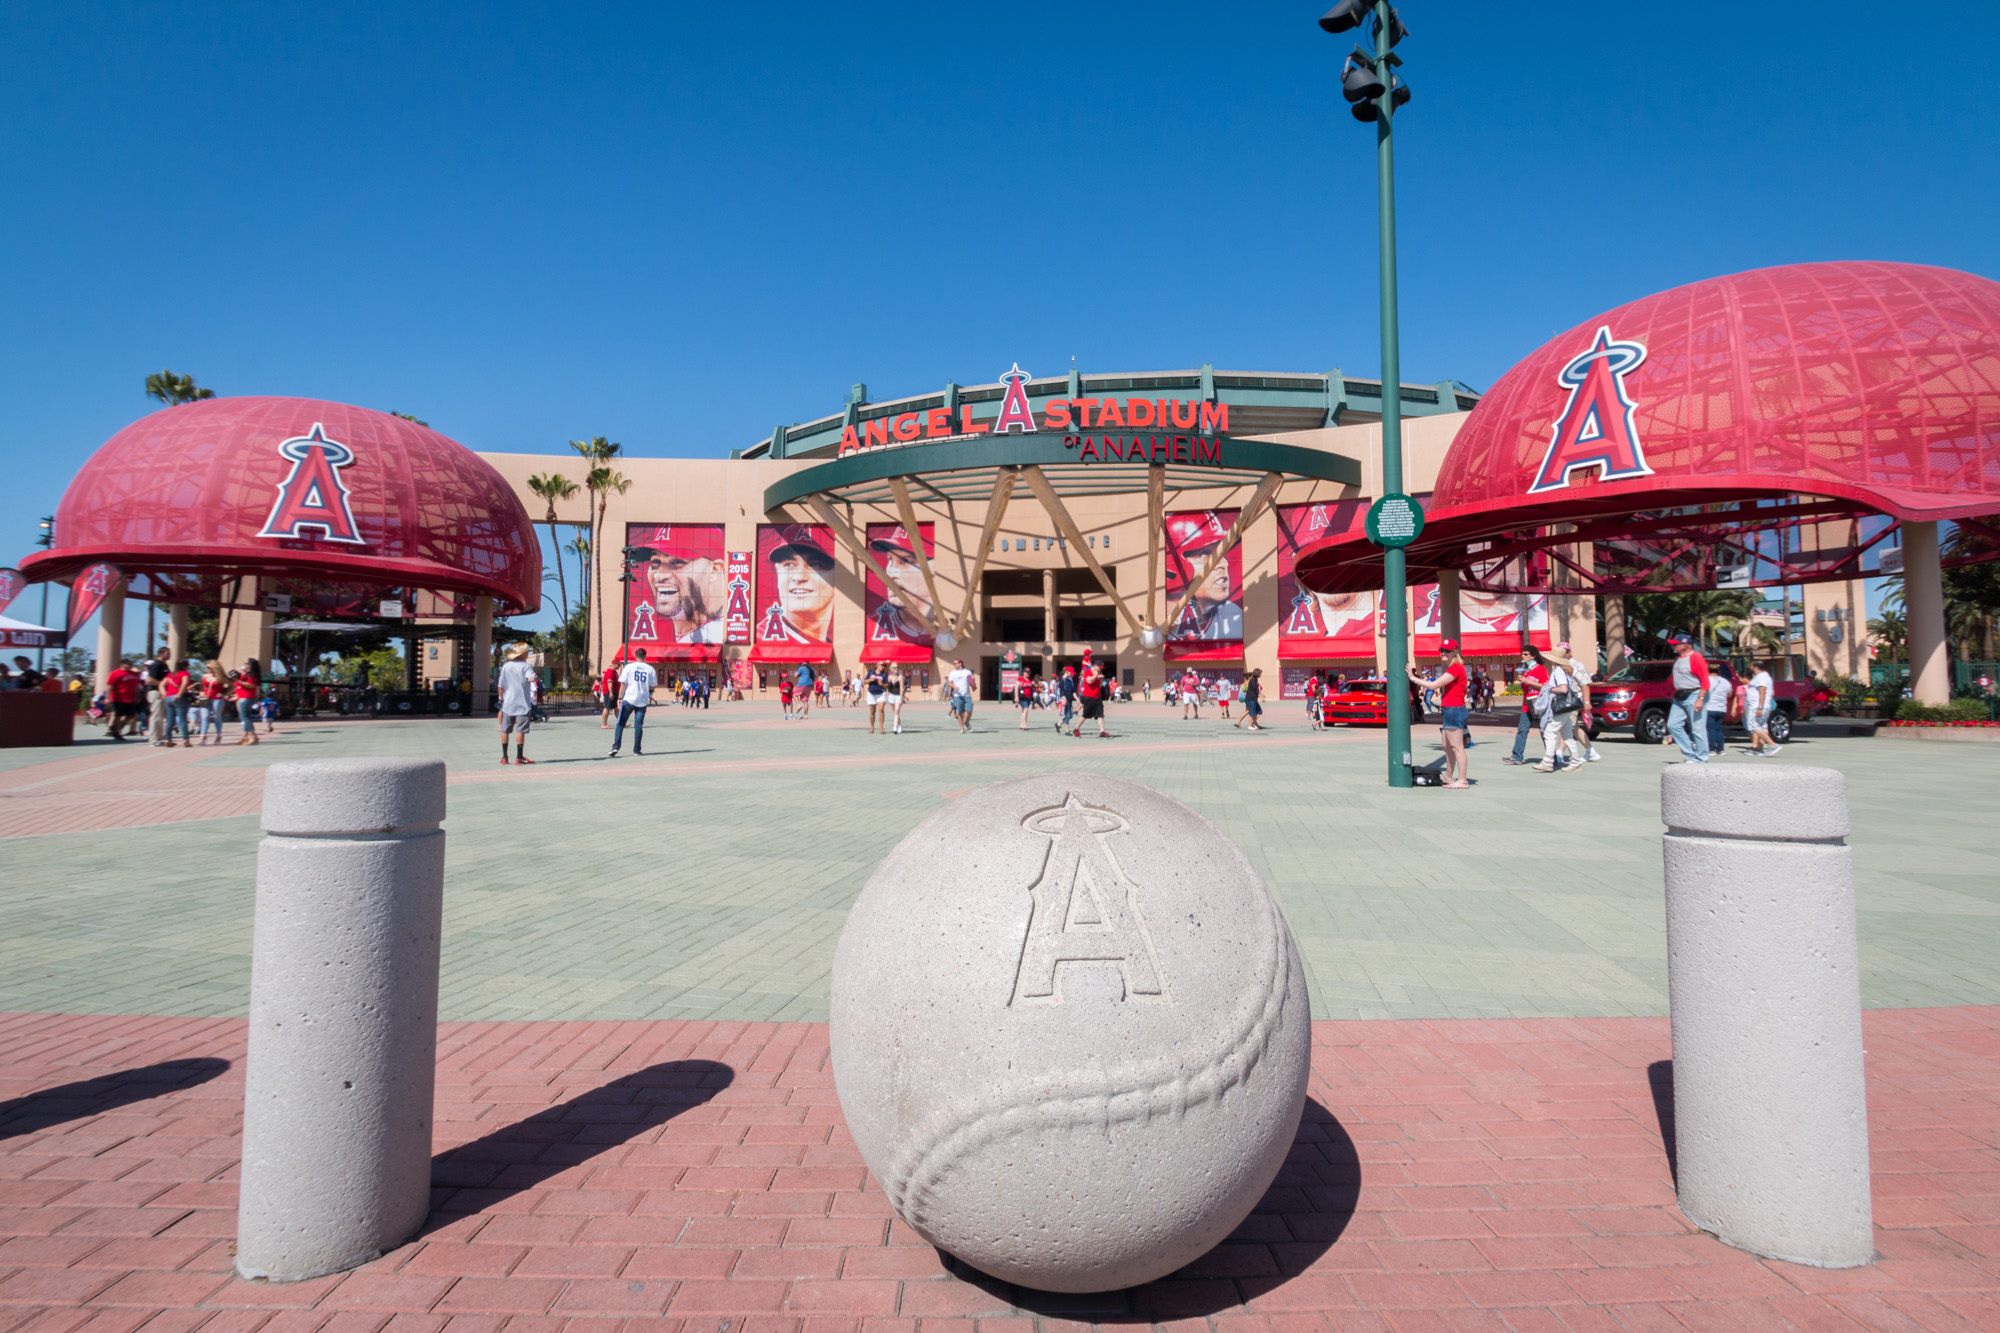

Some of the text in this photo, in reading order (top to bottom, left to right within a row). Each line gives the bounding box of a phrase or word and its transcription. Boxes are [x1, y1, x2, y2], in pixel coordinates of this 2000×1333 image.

[839, 362, 1229, 454] ANGEL A STADIUM
[1526, 325, 1656, 495] A
[1064, 435, 1221, 464] OF ANAHEIM
[255, 421, 367, 544] A
[82, 564, 109, 595] A
[729, 564, 749, 574] 2015
[727, 574, 750, 621] A
[1288, 592, 1318, 634] A
[631, 601, 657, 640] A
[762, 602, 788, 640] A
[872, 602, 899, 640] A
[1829, 626, 1843, 644] 3
[634, 670, 647, 682] 66
[1006, 790, 1176, 1006] A
